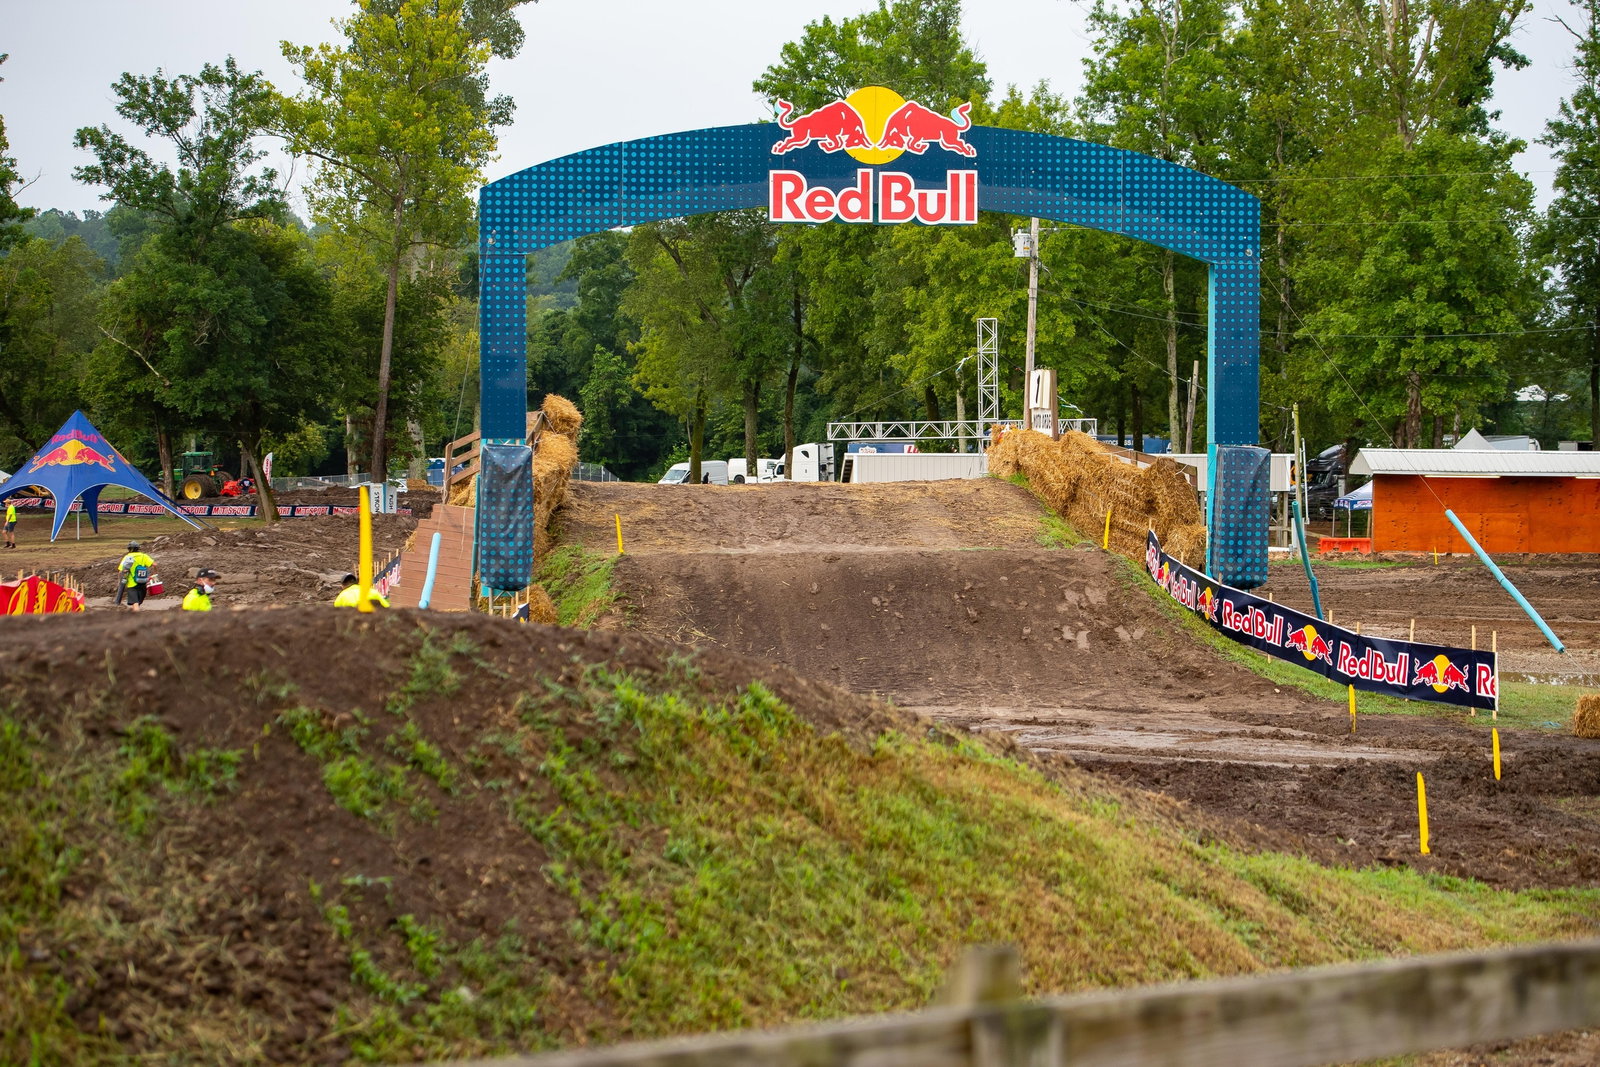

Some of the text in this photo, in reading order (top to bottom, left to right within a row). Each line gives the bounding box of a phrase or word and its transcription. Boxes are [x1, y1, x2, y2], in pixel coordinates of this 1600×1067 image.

[770, 169, 978, 224] Red Bull
[51, 429, 98, 444] Red Bull
[1181, 577, 1197, 611] Bull
[1222, 599, 1284, 647] Red Bull
[1337, 641, 1410, 686] Red Bull
